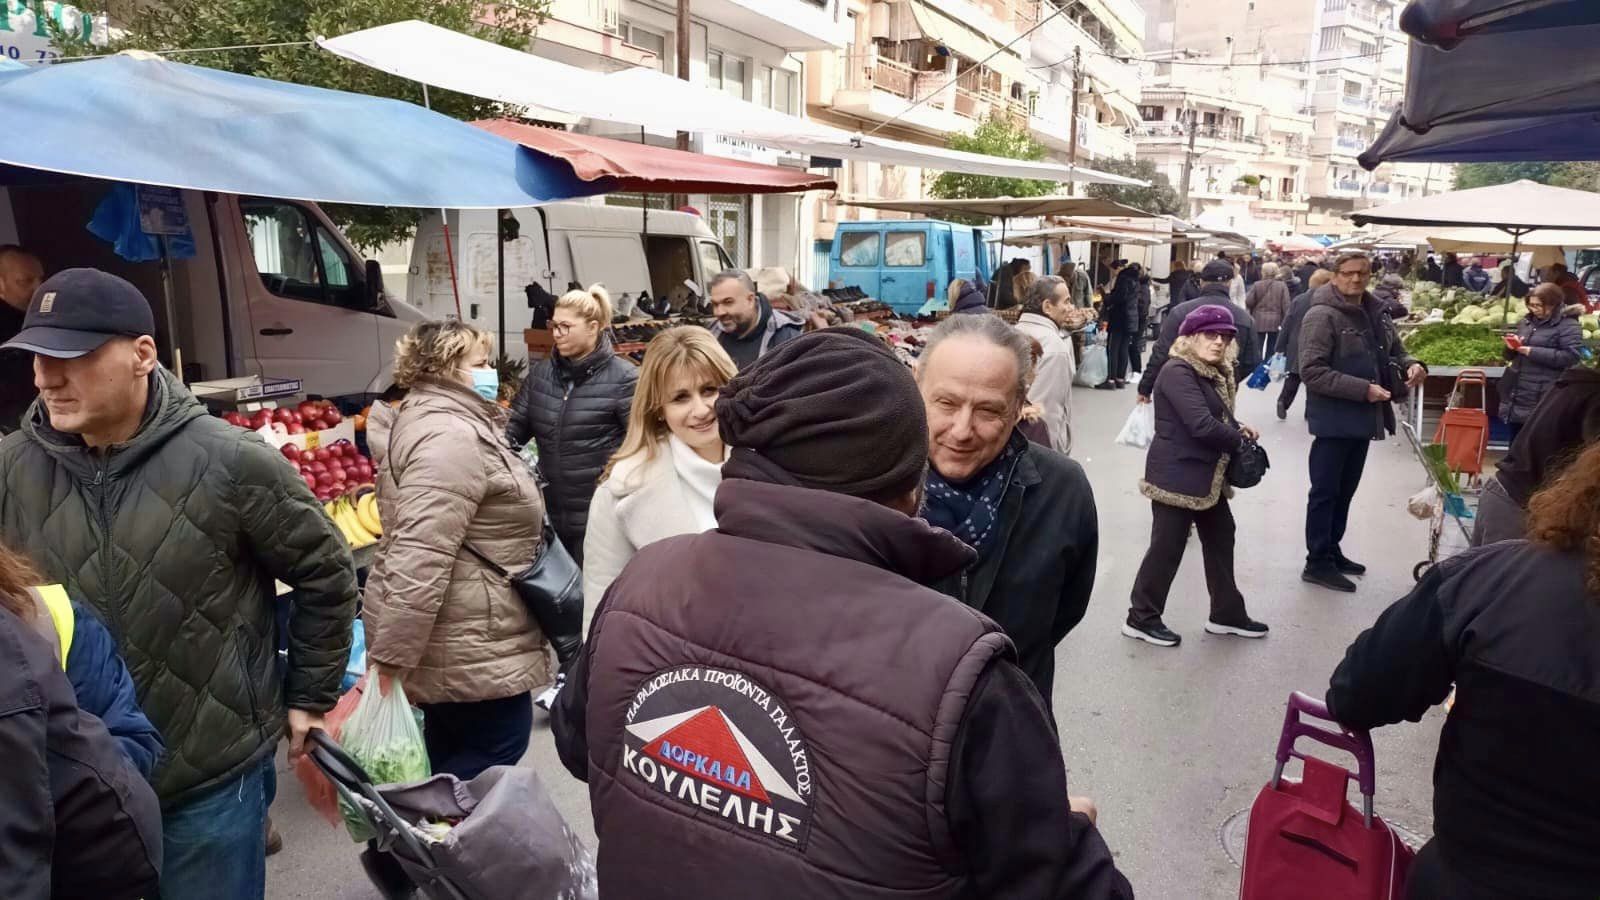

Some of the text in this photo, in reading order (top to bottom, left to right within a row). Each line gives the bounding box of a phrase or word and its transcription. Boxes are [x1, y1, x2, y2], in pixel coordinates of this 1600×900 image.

[626, 668, 811, 796] ΠΑΡΑΔΟΣΙΑΚΑ ΠΡΟΪΟΝΤΑ ΓΑΛΑΚΤΟΣ
[657, 740, 751, 791] ΔΟΡΚΑΔΑ
[623, 743, 801, 843] ΚΟΥΛΕΛΗΣ
